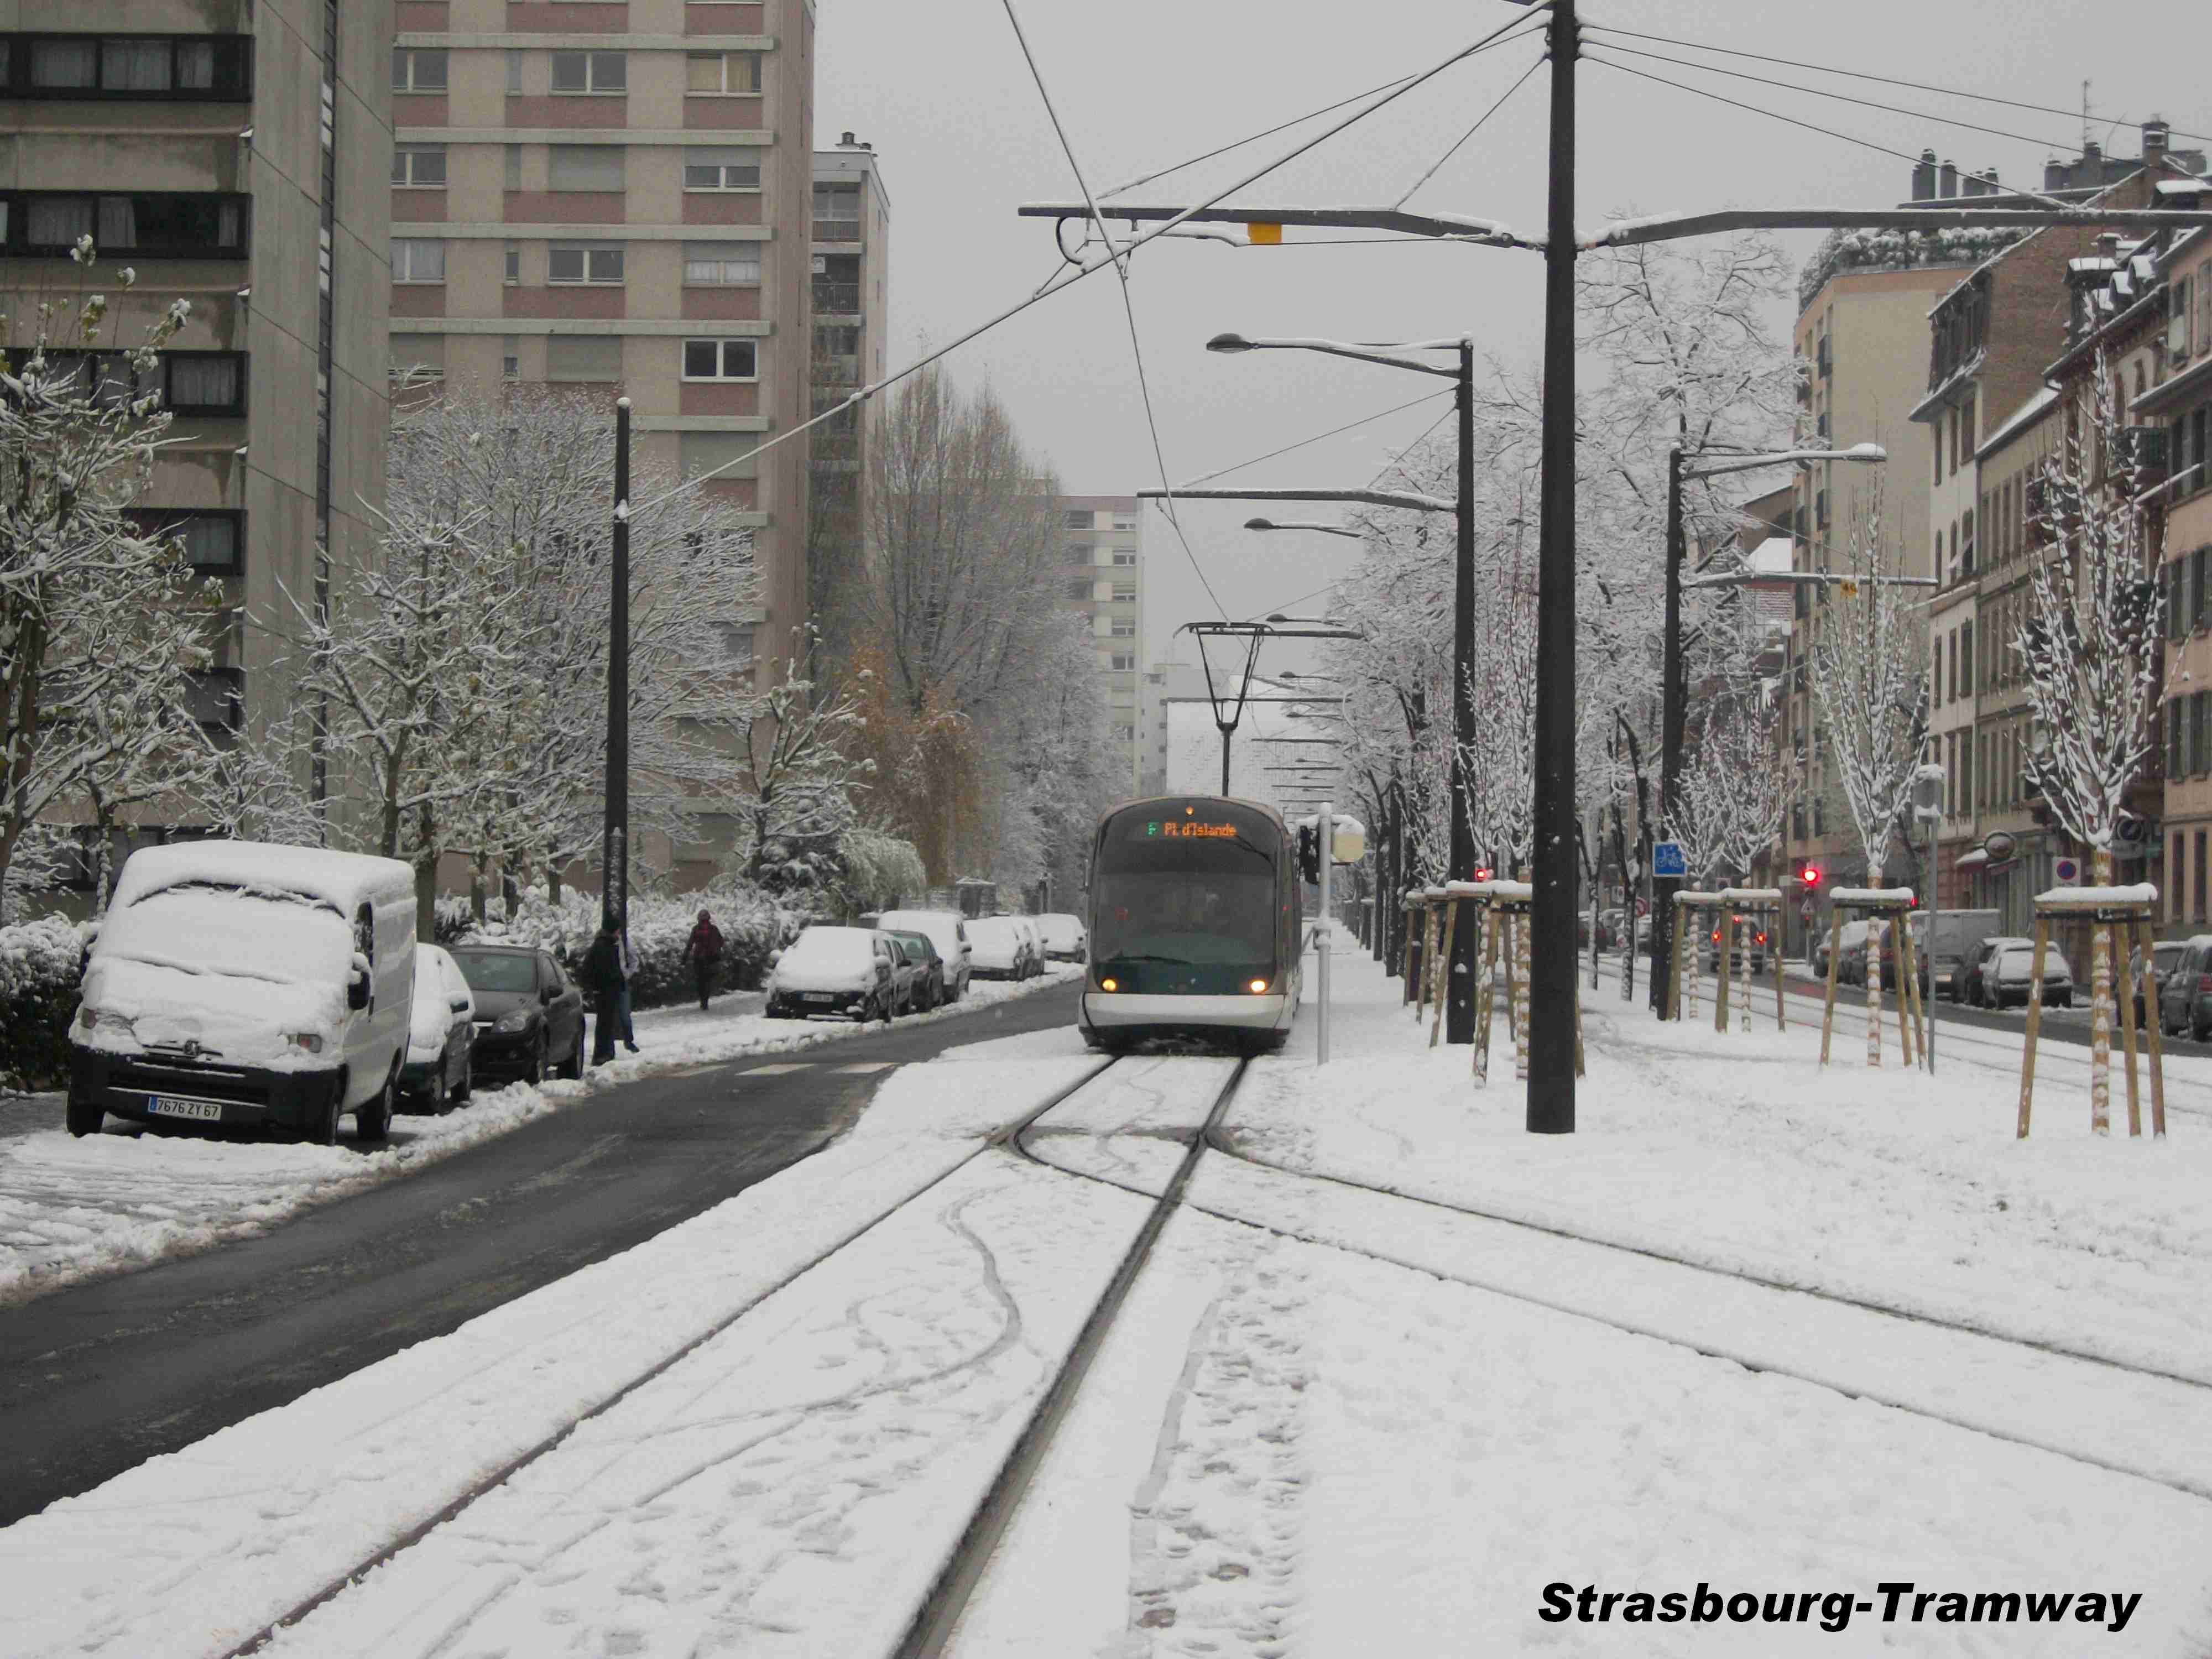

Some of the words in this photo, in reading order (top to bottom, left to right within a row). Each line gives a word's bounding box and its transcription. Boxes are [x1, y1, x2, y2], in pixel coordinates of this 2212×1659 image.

[158, 1100, 185, 1114] 7676
[187, 1103, 201, 1115] ZY
[204, 1105, 218, 1117] 67
